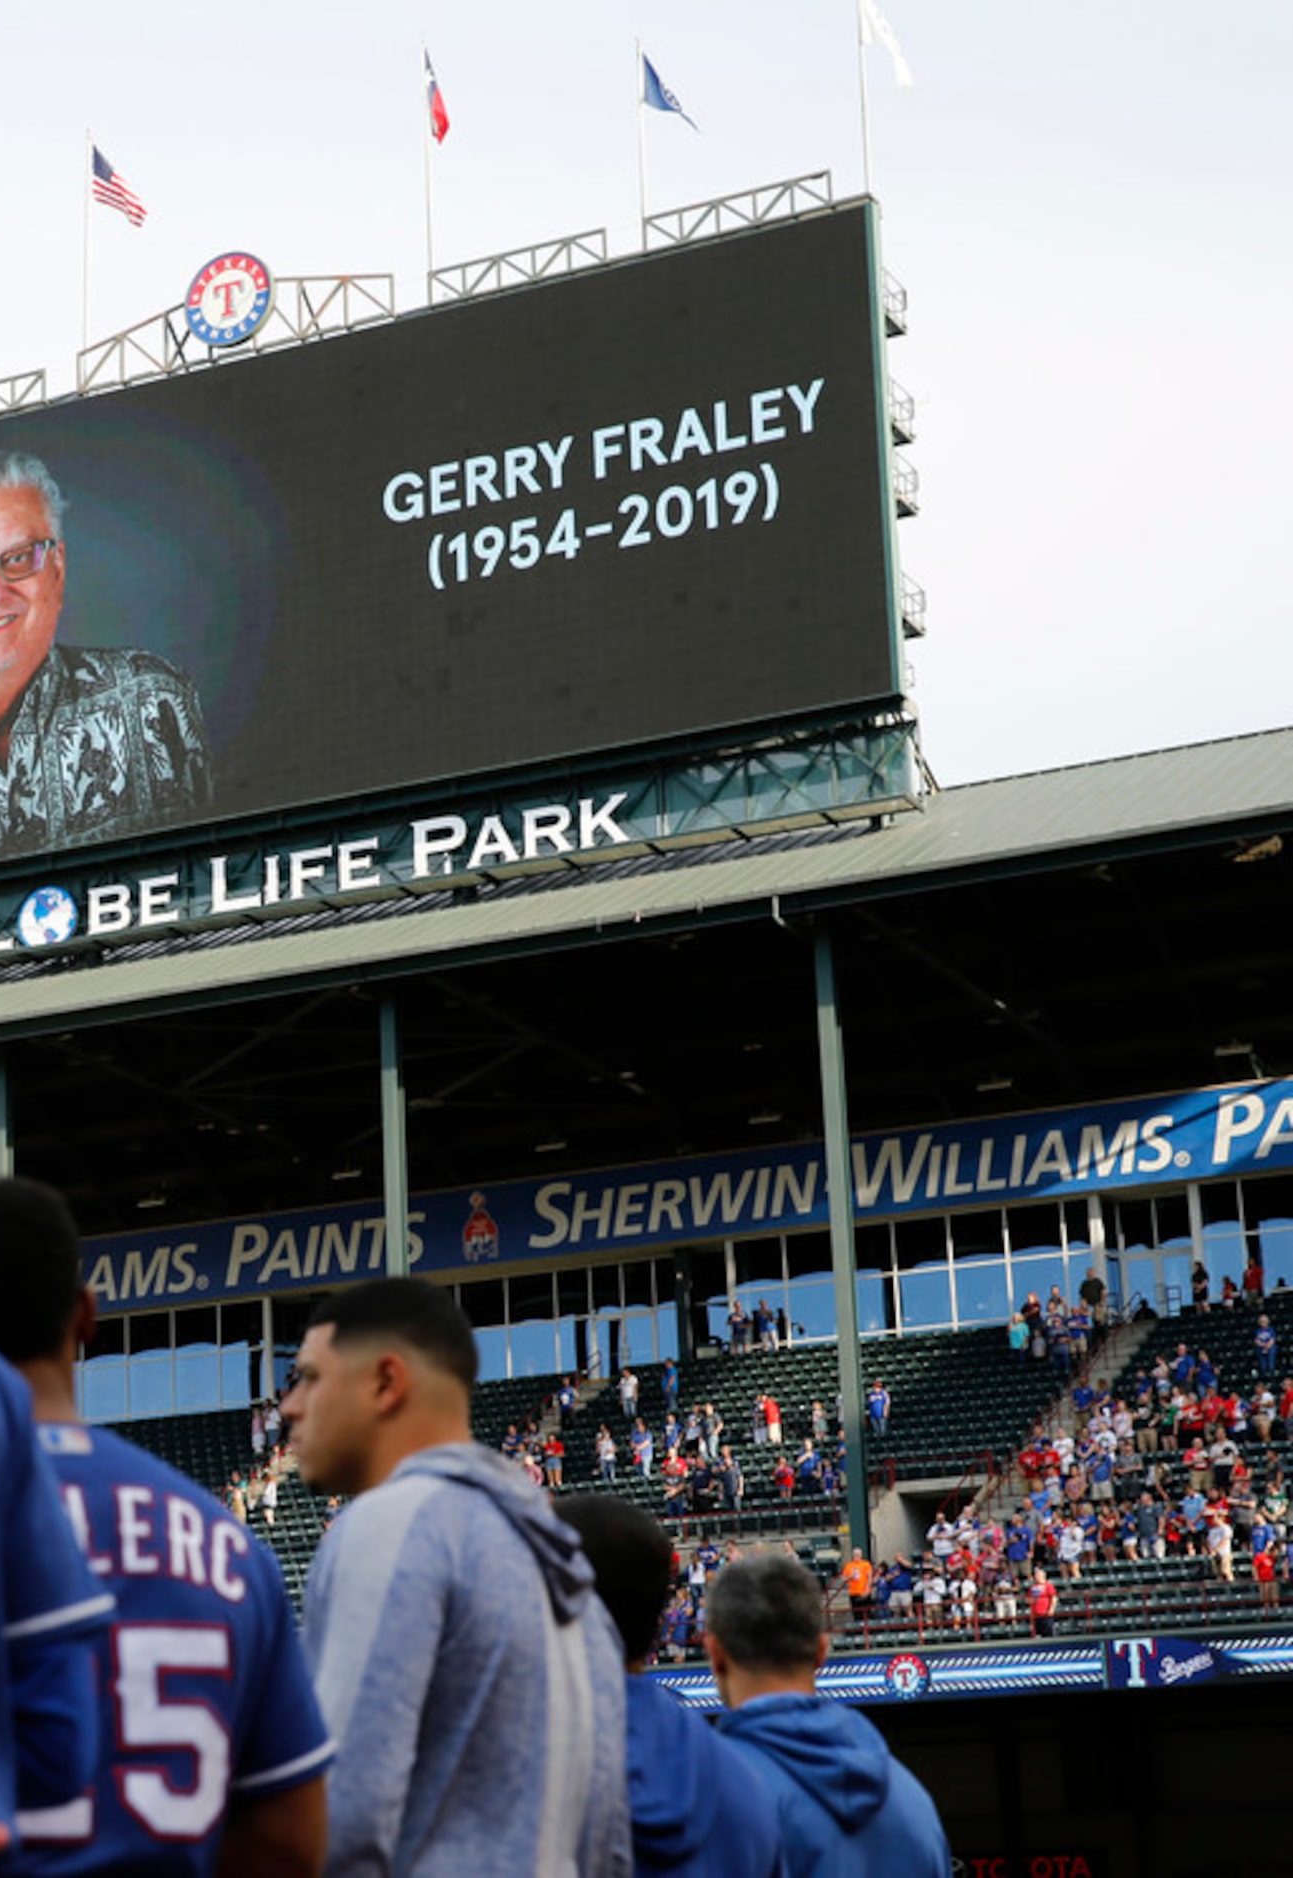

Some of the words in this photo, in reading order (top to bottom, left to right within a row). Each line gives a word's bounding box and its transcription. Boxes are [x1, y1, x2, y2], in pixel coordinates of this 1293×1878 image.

[382, 436, 574, 522] GERRY
[592, 378, 825, 480] FRALEY
[427, 463, 780, 590] (1954-2019)
[209, 836, 381, 917] LIFE
[410, 791, 630, 880] PARK
[80, 1243, 198, 1302] AMS
[61, 1483, 250, 1604] LERC
[969, 1856, 1093, 1878] TOOTA
